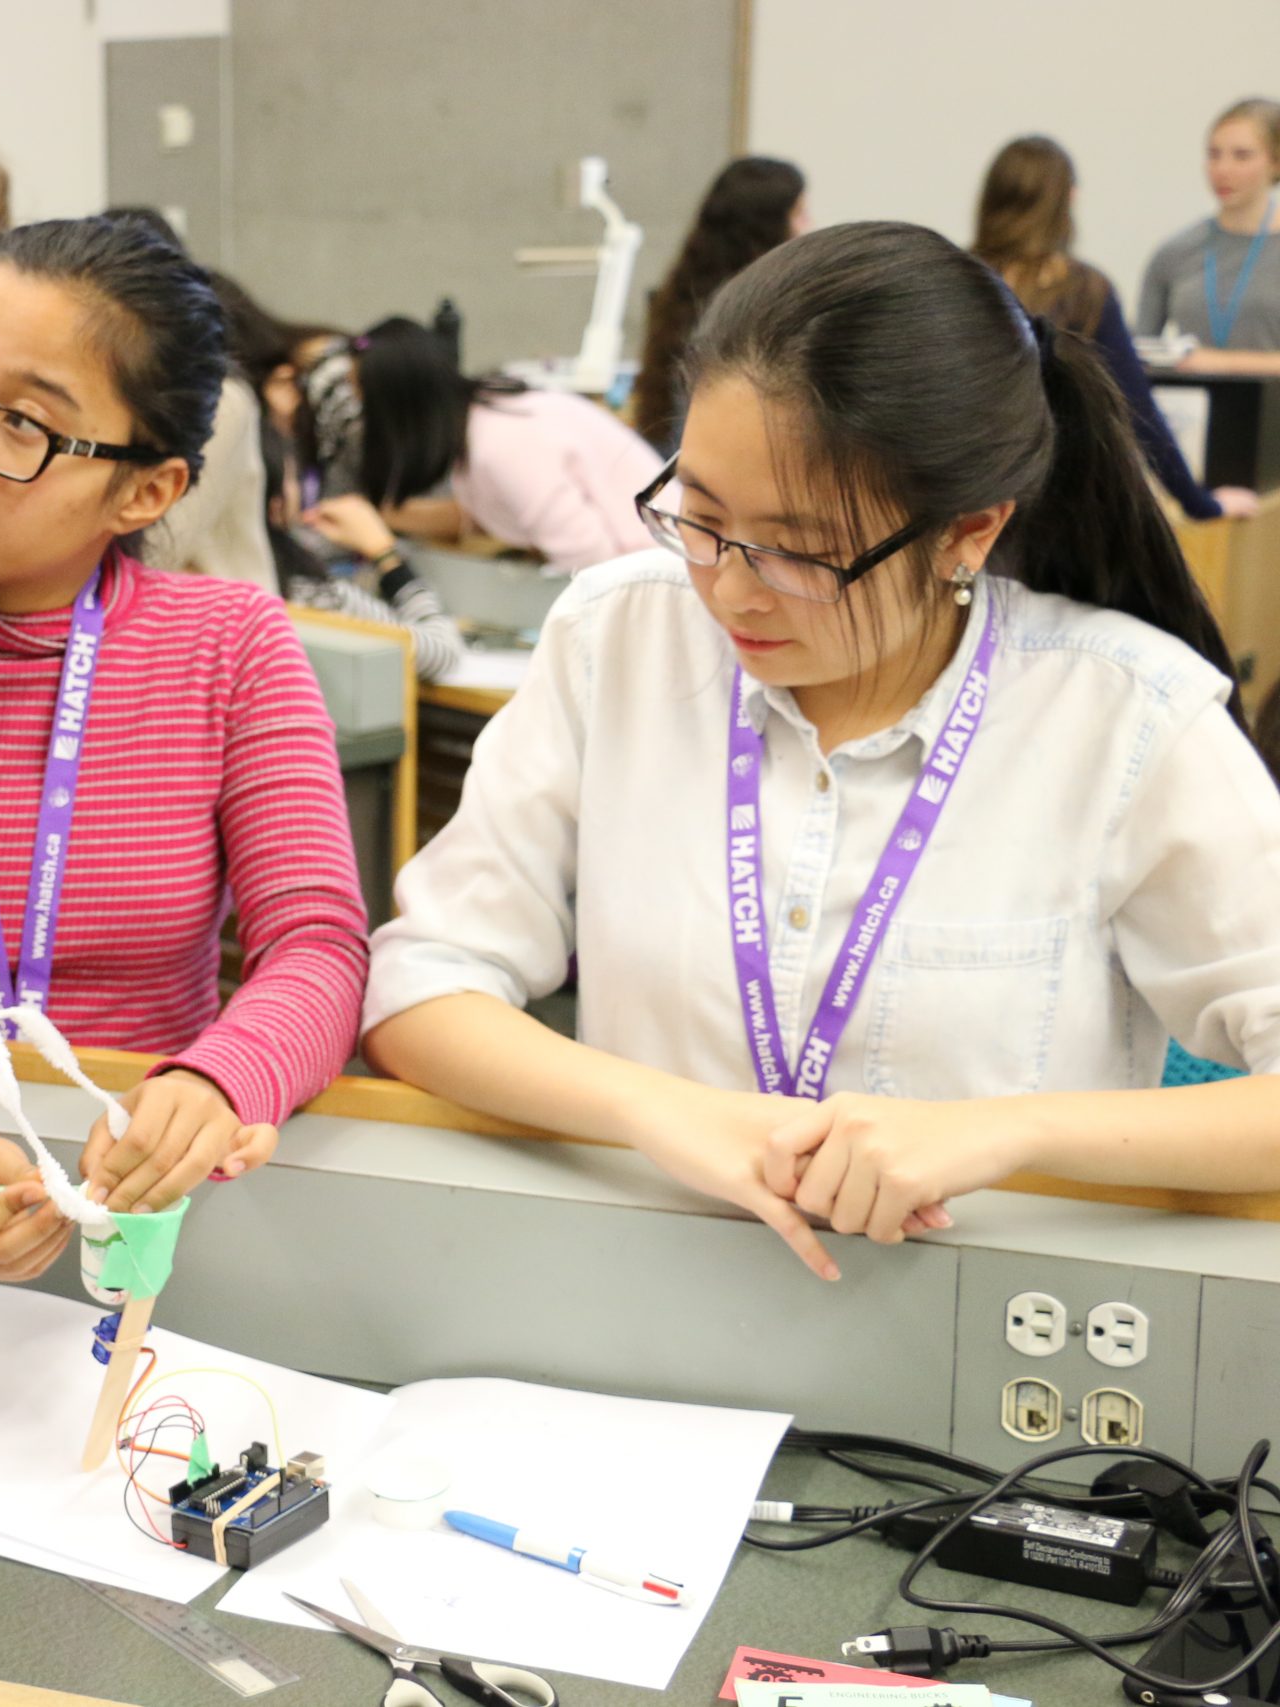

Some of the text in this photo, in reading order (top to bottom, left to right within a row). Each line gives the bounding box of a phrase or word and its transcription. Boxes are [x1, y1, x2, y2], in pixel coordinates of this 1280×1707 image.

[58, 631, 97, 732] HATCH
[932, 670, 987, 776] HATCH
[31, 833, 61, 959] www.hatch.ca
[731, 835, 760, 945] HATCH
[832, 876, 899, 1007] www.hatch.ca
[829, 1691, 949, 1699] ENGINEERING BUCKS
